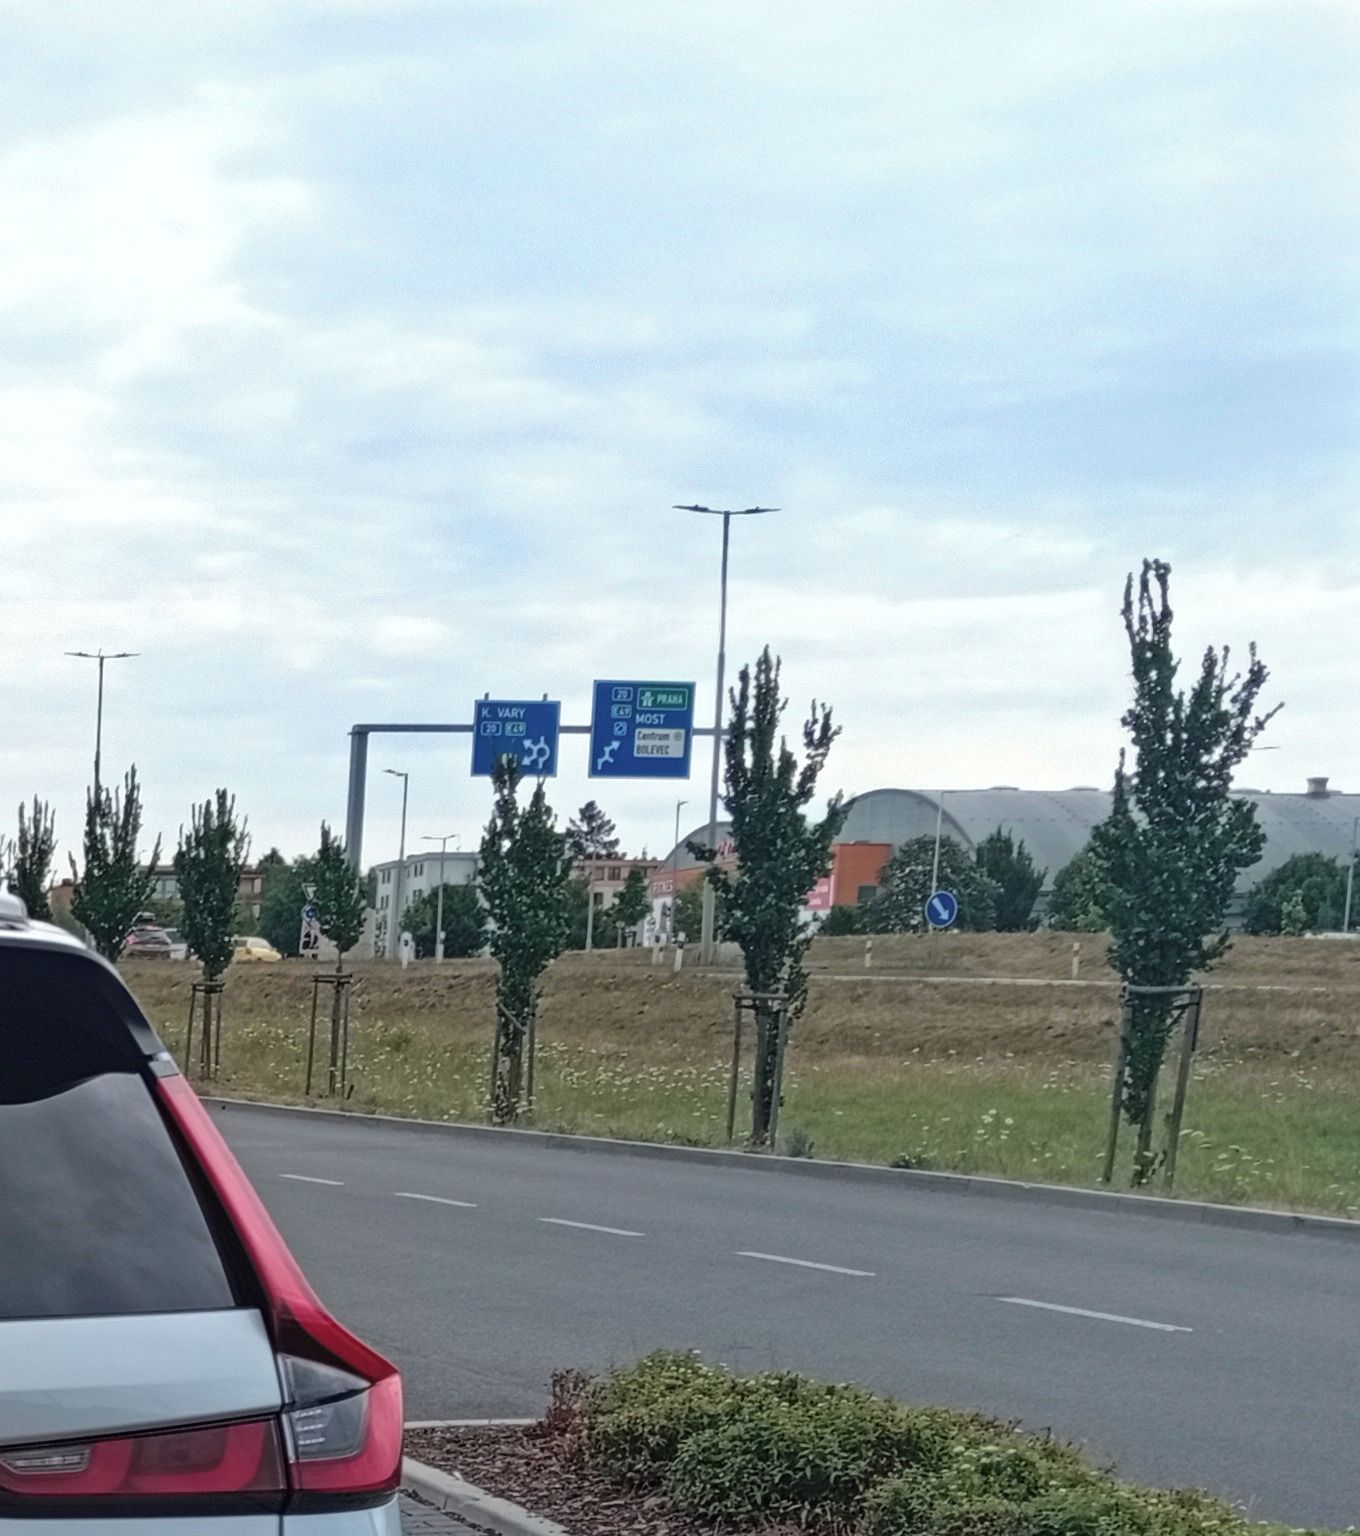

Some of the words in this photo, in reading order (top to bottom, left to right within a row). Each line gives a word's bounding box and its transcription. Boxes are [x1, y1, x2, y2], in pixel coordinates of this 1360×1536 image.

[656, 693, 683, 705] PRAHA
[497, 707, 526, 719] VARY
[635, 713, 666, 725] MOST
[637, 730, 670, 741] Centrum
